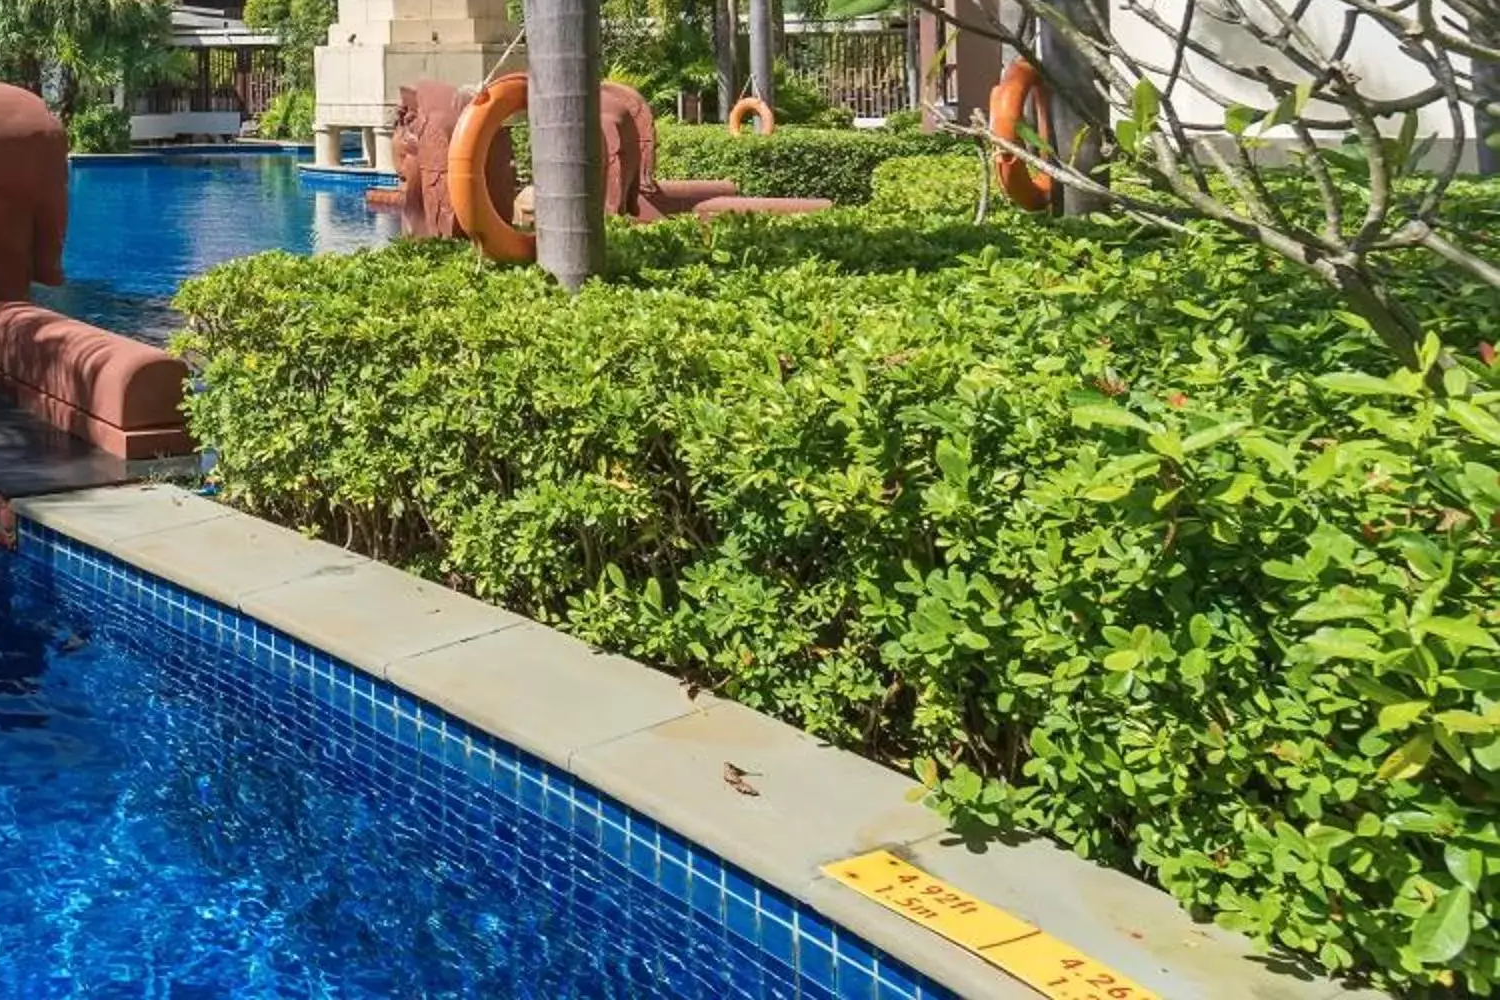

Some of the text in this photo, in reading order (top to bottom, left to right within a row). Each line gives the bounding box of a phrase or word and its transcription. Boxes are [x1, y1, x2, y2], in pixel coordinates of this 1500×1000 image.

[874, 885, 938, 918] 1.5m
[898, 875, 978, 914] 4.92ft
[1060, 959, 1148, 1000] 4.26
